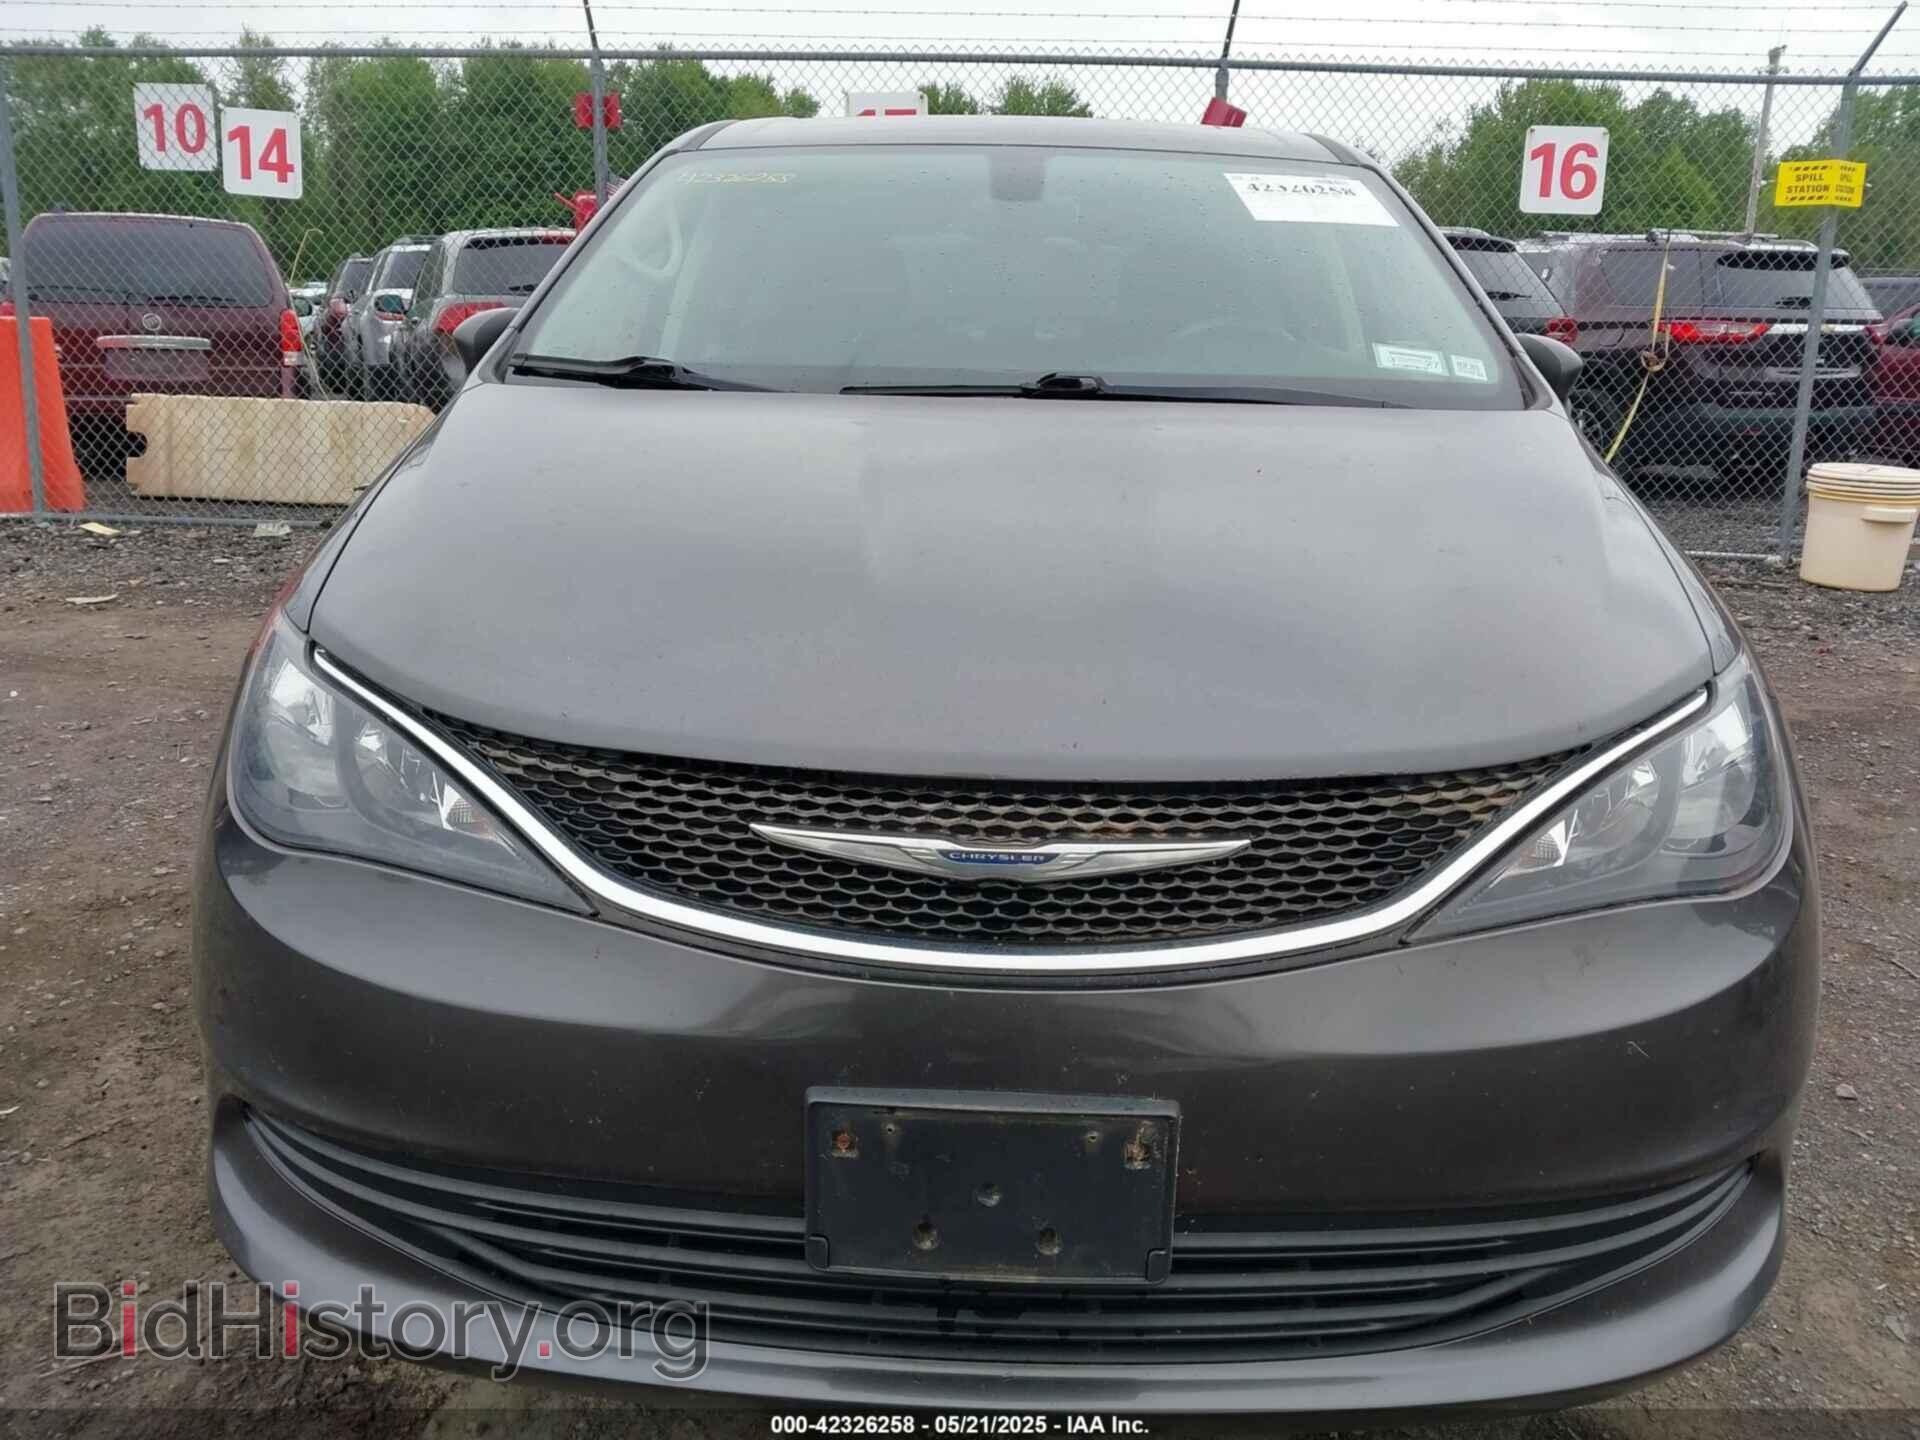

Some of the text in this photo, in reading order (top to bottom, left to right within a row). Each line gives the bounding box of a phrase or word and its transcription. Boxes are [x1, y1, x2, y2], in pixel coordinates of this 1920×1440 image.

[143, 103, 207, 154] 10
[228, 125, 295, 183] 14
[1530, 142, 1599, 200] 16
[1795, 173, 1825, 182] SPILL
[1786, 184, 1830, 194] STATION
[949, 851, 1046, 862] CHRYSLER
